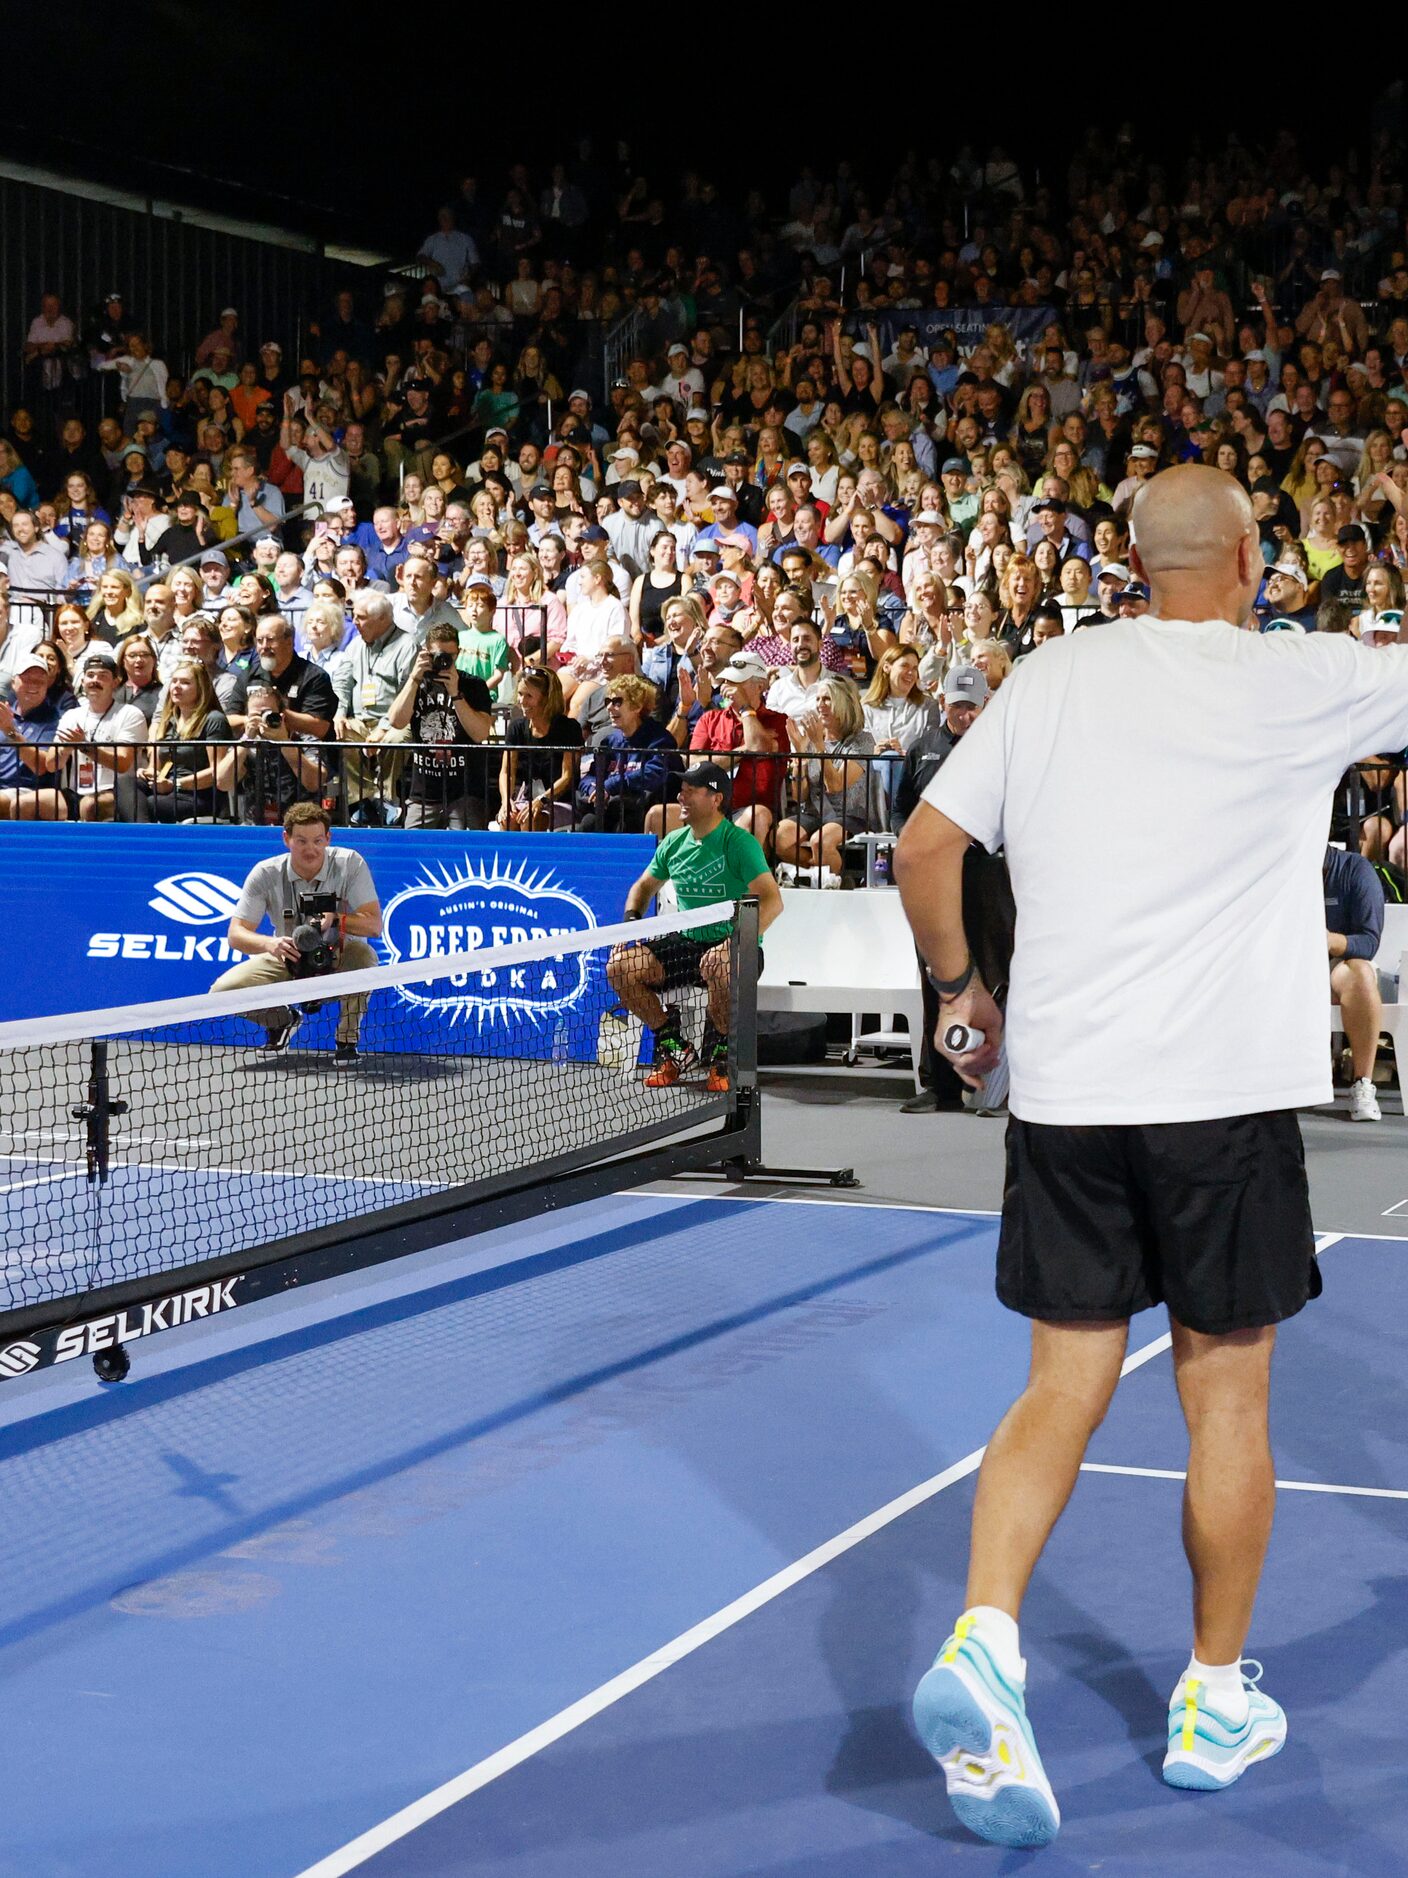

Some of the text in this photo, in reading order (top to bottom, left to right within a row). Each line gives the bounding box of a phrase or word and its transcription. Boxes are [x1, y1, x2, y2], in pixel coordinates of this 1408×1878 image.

[309, 482, 324, 499] 41
[439, 901, 538, 919] AUSTIN'S ORIGINAL
[86, 933, 242, 962] SELKI
[424, 967, 557, 990] ODKA
[54, 1277, 239, 1365] SELKIRK
